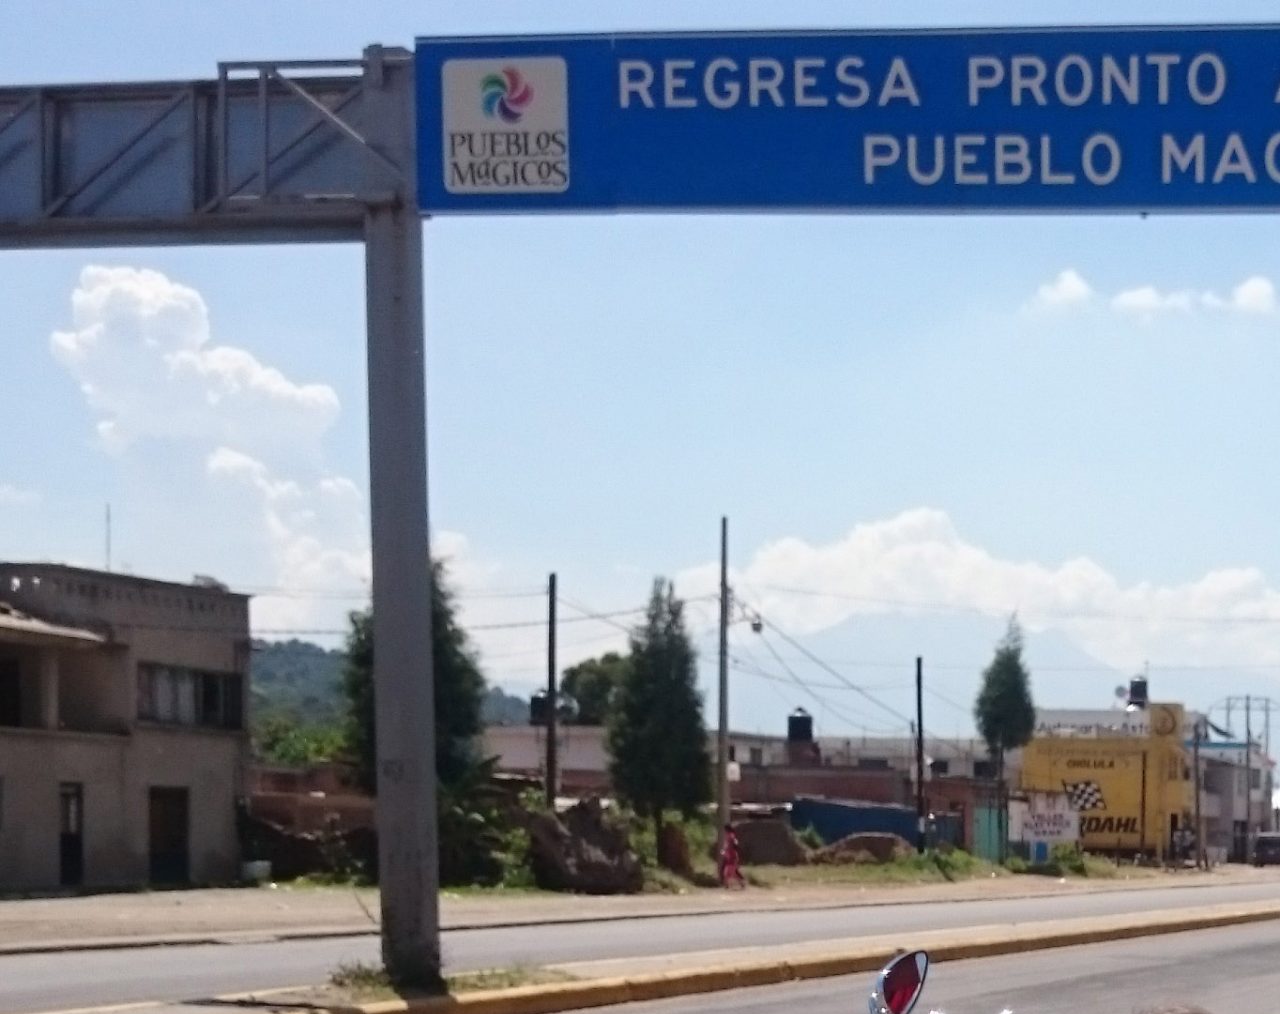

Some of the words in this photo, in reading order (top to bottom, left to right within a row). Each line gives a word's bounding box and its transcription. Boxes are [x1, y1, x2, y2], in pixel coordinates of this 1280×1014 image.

[618, 57, 920, 109] REGRESA
[968, 52, 1227, 106] PRONTO
[863, 133, 1122, 186] PUEBLO
